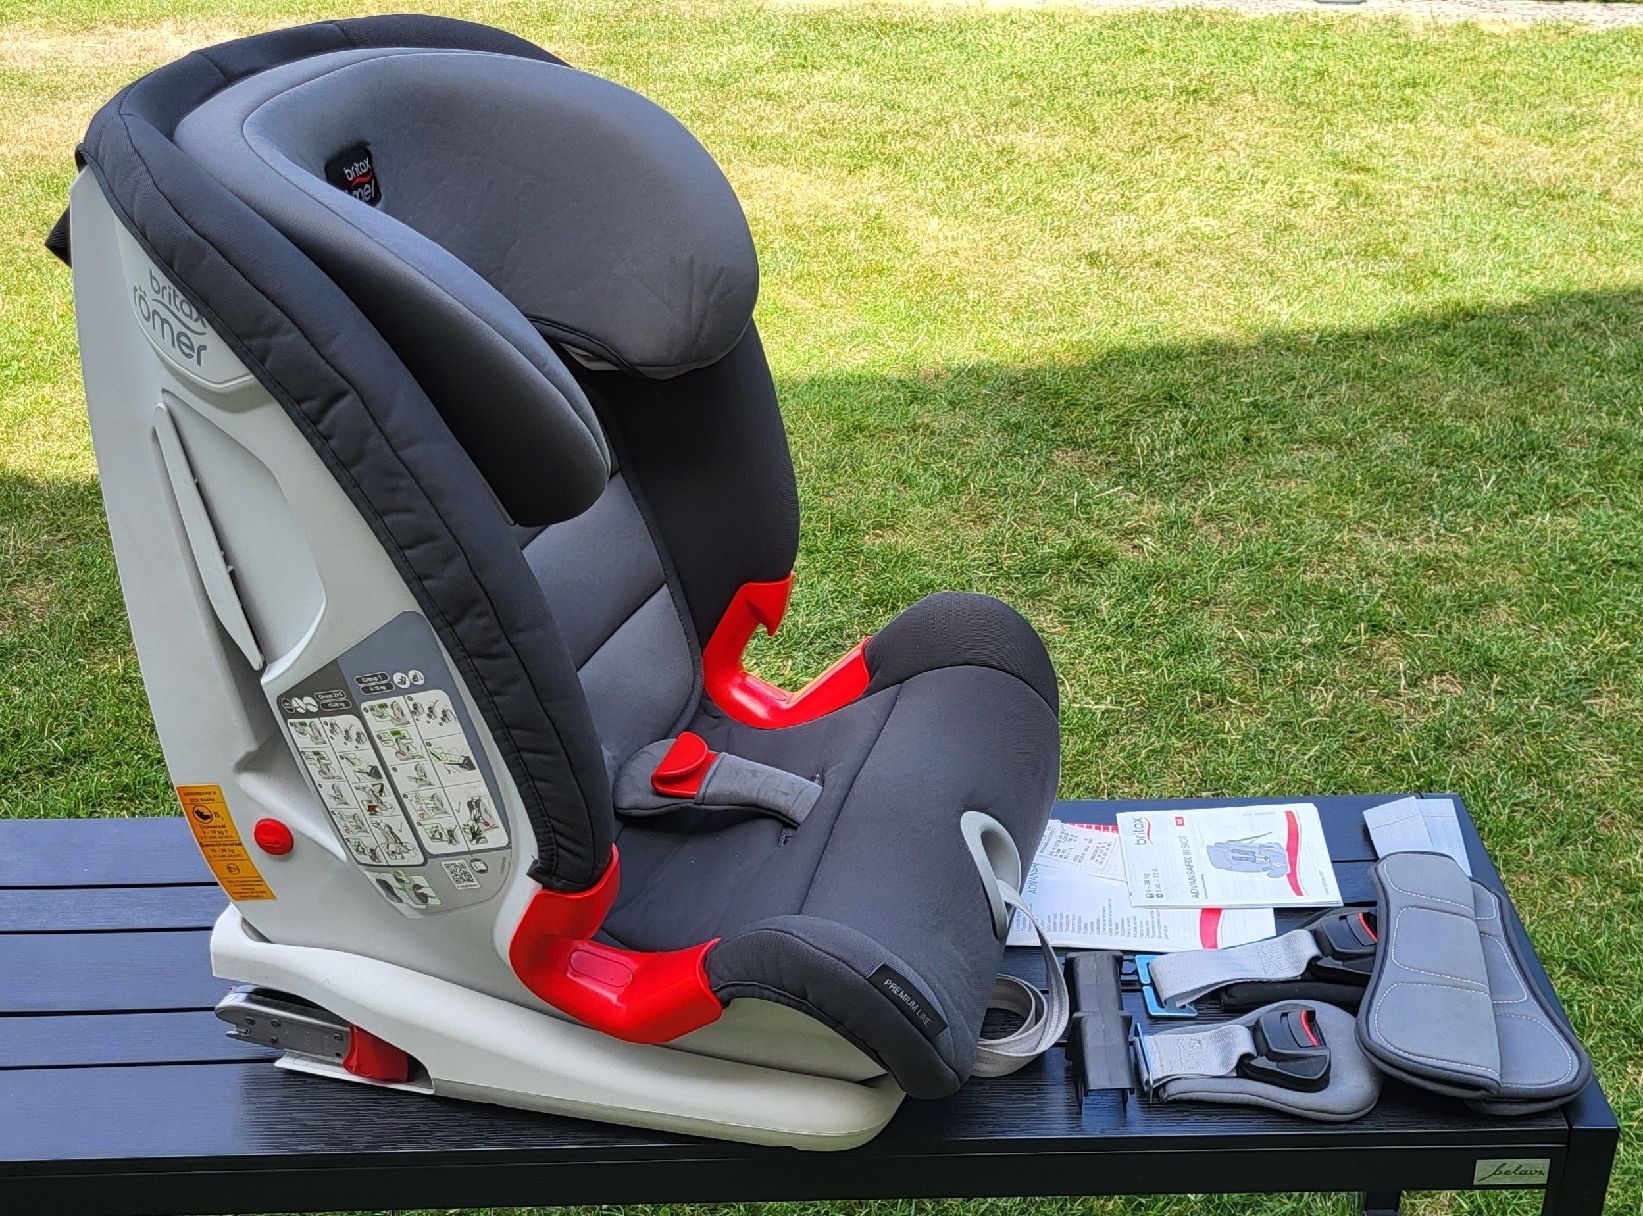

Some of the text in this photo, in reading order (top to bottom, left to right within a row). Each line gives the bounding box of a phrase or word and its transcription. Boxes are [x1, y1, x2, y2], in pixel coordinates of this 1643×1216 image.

[343, 156, 372, 181] britax
[133, 286, 208, 367] römer
[1131, 816, 1147, 846] britax
[883, 978, 932, 1027] PREMIUM LINE
[1477, 1162, 1546, 1183] belavi
